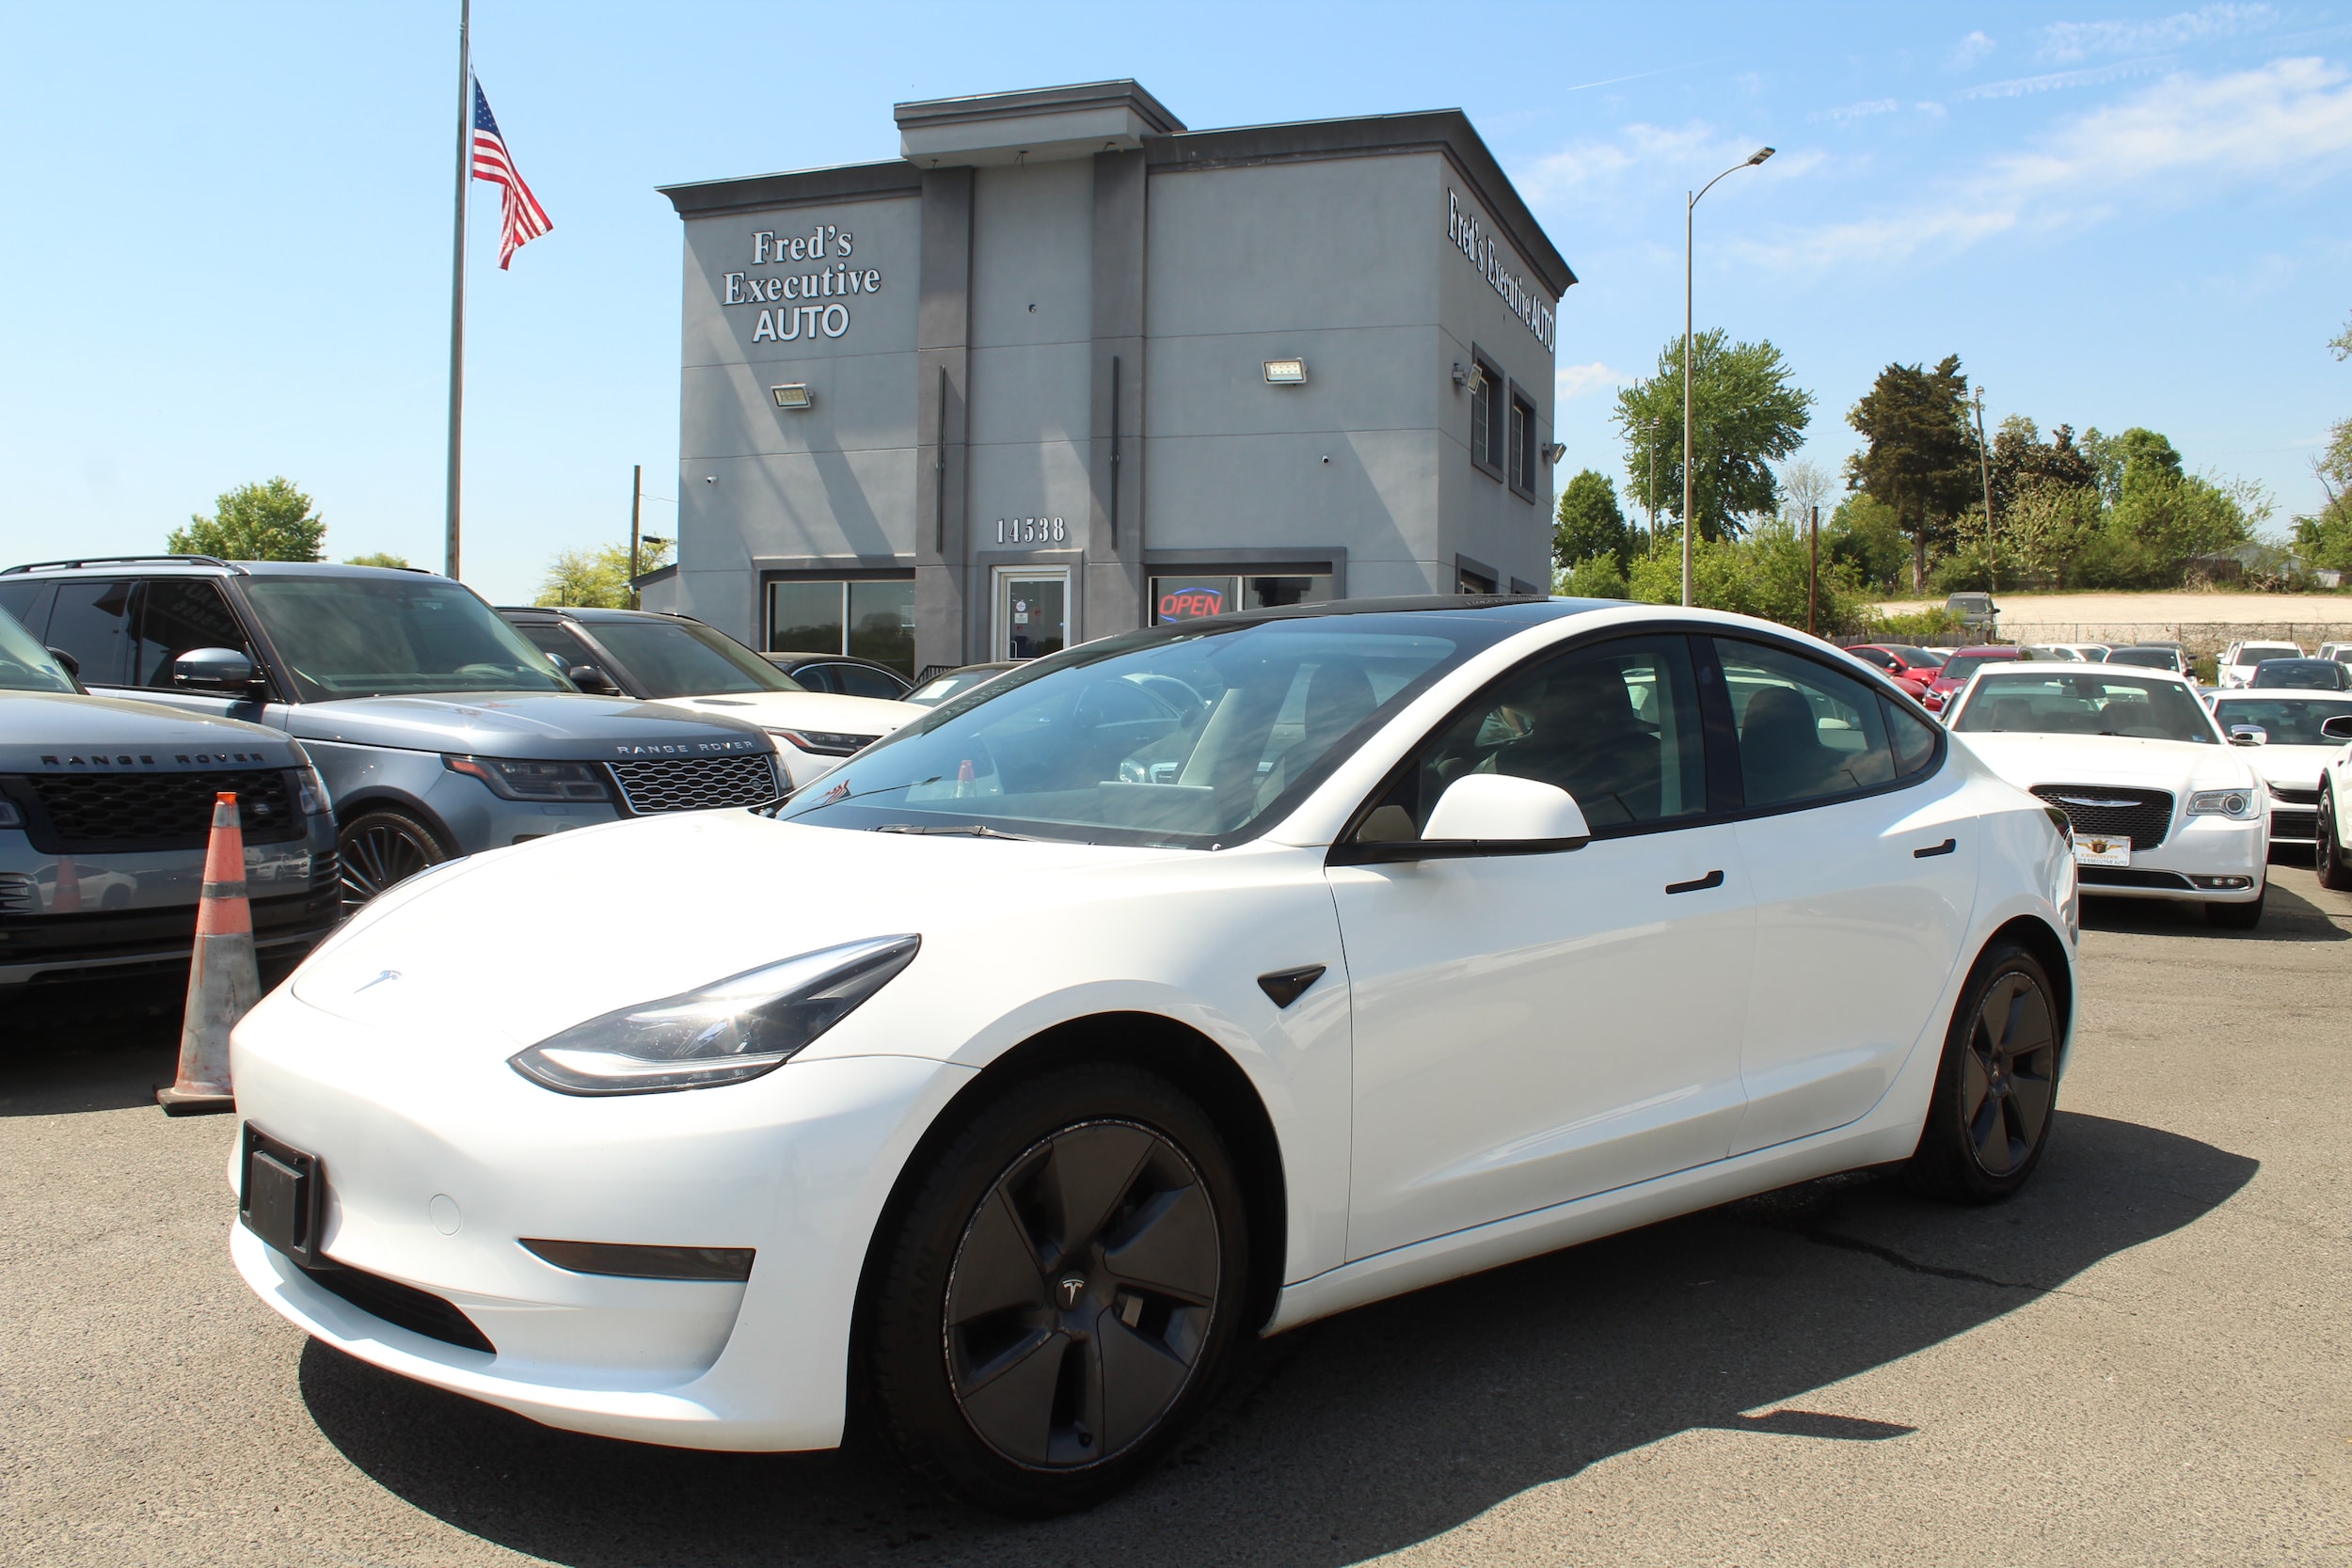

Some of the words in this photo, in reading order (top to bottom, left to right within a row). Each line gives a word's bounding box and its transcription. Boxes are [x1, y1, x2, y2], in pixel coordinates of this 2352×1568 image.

[751, 225, 853, 265] Fred's
[722, 262, 882, 307] Executive
[1447, 187, 1484, 273] Fred's
[1486, 234, 1531, 327] Executive
[1531, 293, 1555, 354] AUTO
[752, 303, 850, 344] AUTO
[996, 516, 1065, 544] 14538
[1158, 594, 1223, 617] OPEN
[40, 753, 155, 767] RANGE
[174, 752, 265, 765] ROVER
[617, 744, 688, 755] RANGE
[698, 740, 754, 752] ROVER
